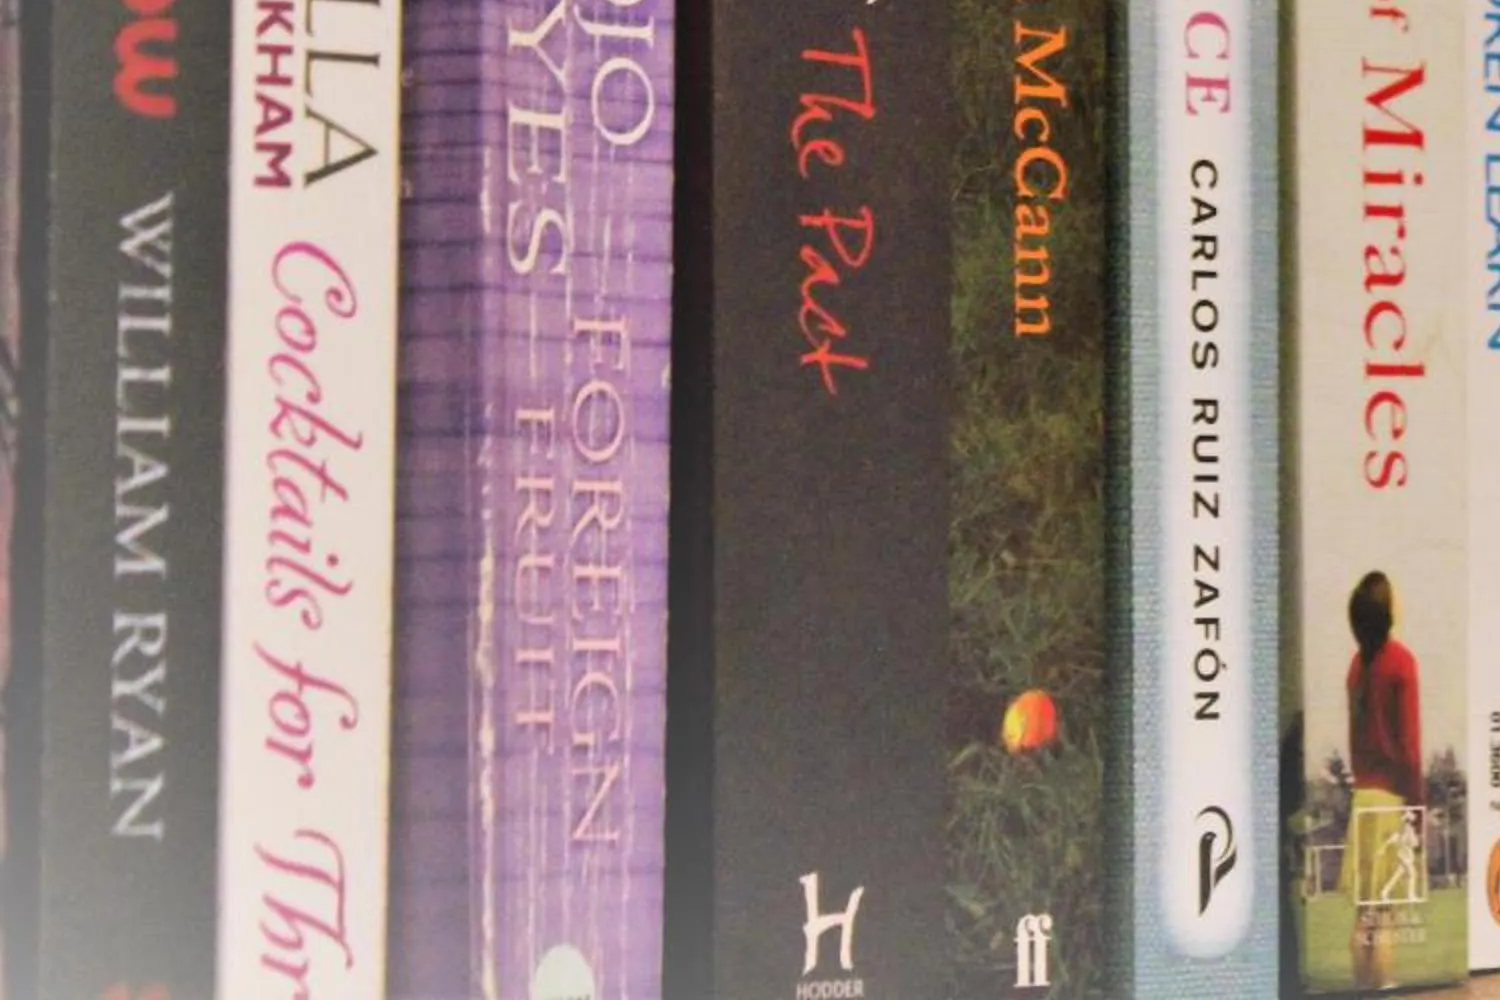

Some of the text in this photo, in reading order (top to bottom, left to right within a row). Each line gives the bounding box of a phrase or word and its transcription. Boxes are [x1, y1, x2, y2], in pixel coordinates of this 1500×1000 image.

[790, 26, 876, 395] The Past
[1012, 20, 1069, 336] McCann
[1360, 57, 1427, 491] Miracles
[108, 190, 174, 842] WILLIAM RYAN
[264, 239, 364, 631] Cocktails
[512, 404, 558, 757] FRUIT
[562, 314, 634, 848] FOREIGN
[1189, 158, 1227, 722] CARLOS RUIZ ZAFÓN
[252, 639, 360, 790] for
[796, 979, 865, 1000] HODDER
